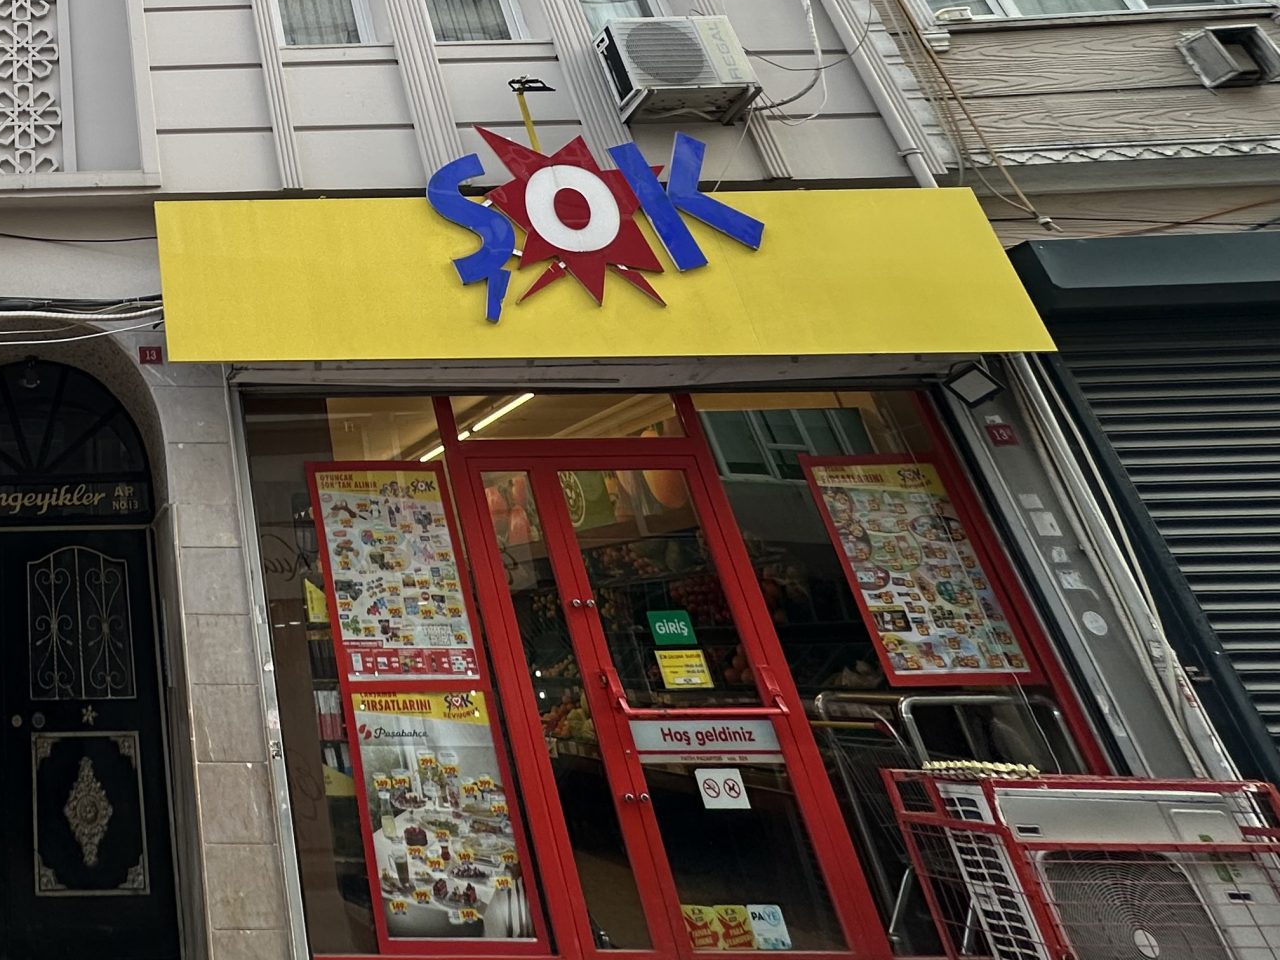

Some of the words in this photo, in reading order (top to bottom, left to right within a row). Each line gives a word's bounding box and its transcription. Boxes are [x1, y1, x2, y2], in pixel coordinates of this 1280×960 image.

[425, 131, 765, 323] ŞOK
[146, 350, 157, 360] 13
[655, 618, 689, 637] GİRİŞ
[373, 726, 429, 740] Paşabahçe
[660, 727, 691, 746] Hoş
[695, 726, 756, 746] geldiniz
